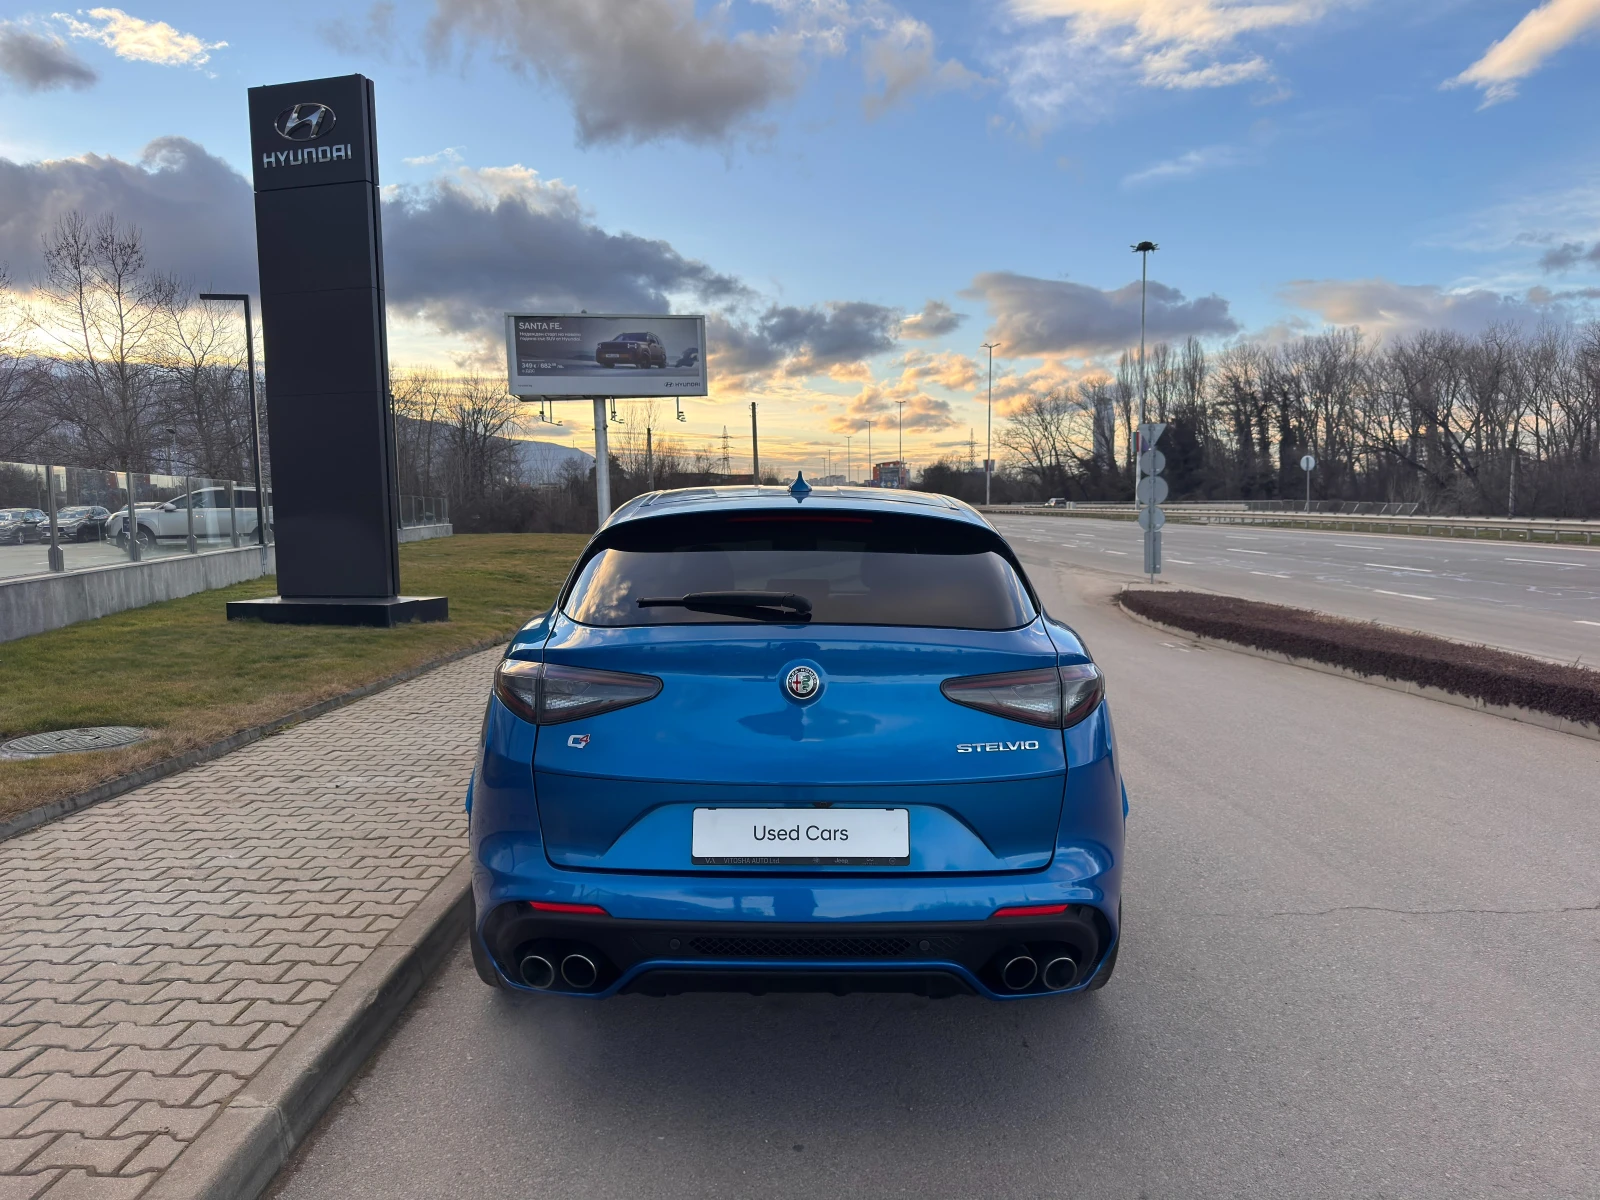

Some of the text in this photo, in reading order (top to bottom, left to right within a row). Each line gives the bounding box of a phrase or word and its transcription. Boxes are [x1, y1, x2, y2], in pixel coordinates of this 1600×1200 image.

[262, 144, 352, 168] HYUNDAI
[518, 322, 562, 330] SANTA FE.
[800, 668, 817, 684] ROMEO
[956, 740, 1039, 753] STELVIO
[753, 825, 849, 841] Used Cars
[834, 857, 849, 865] Jeep
